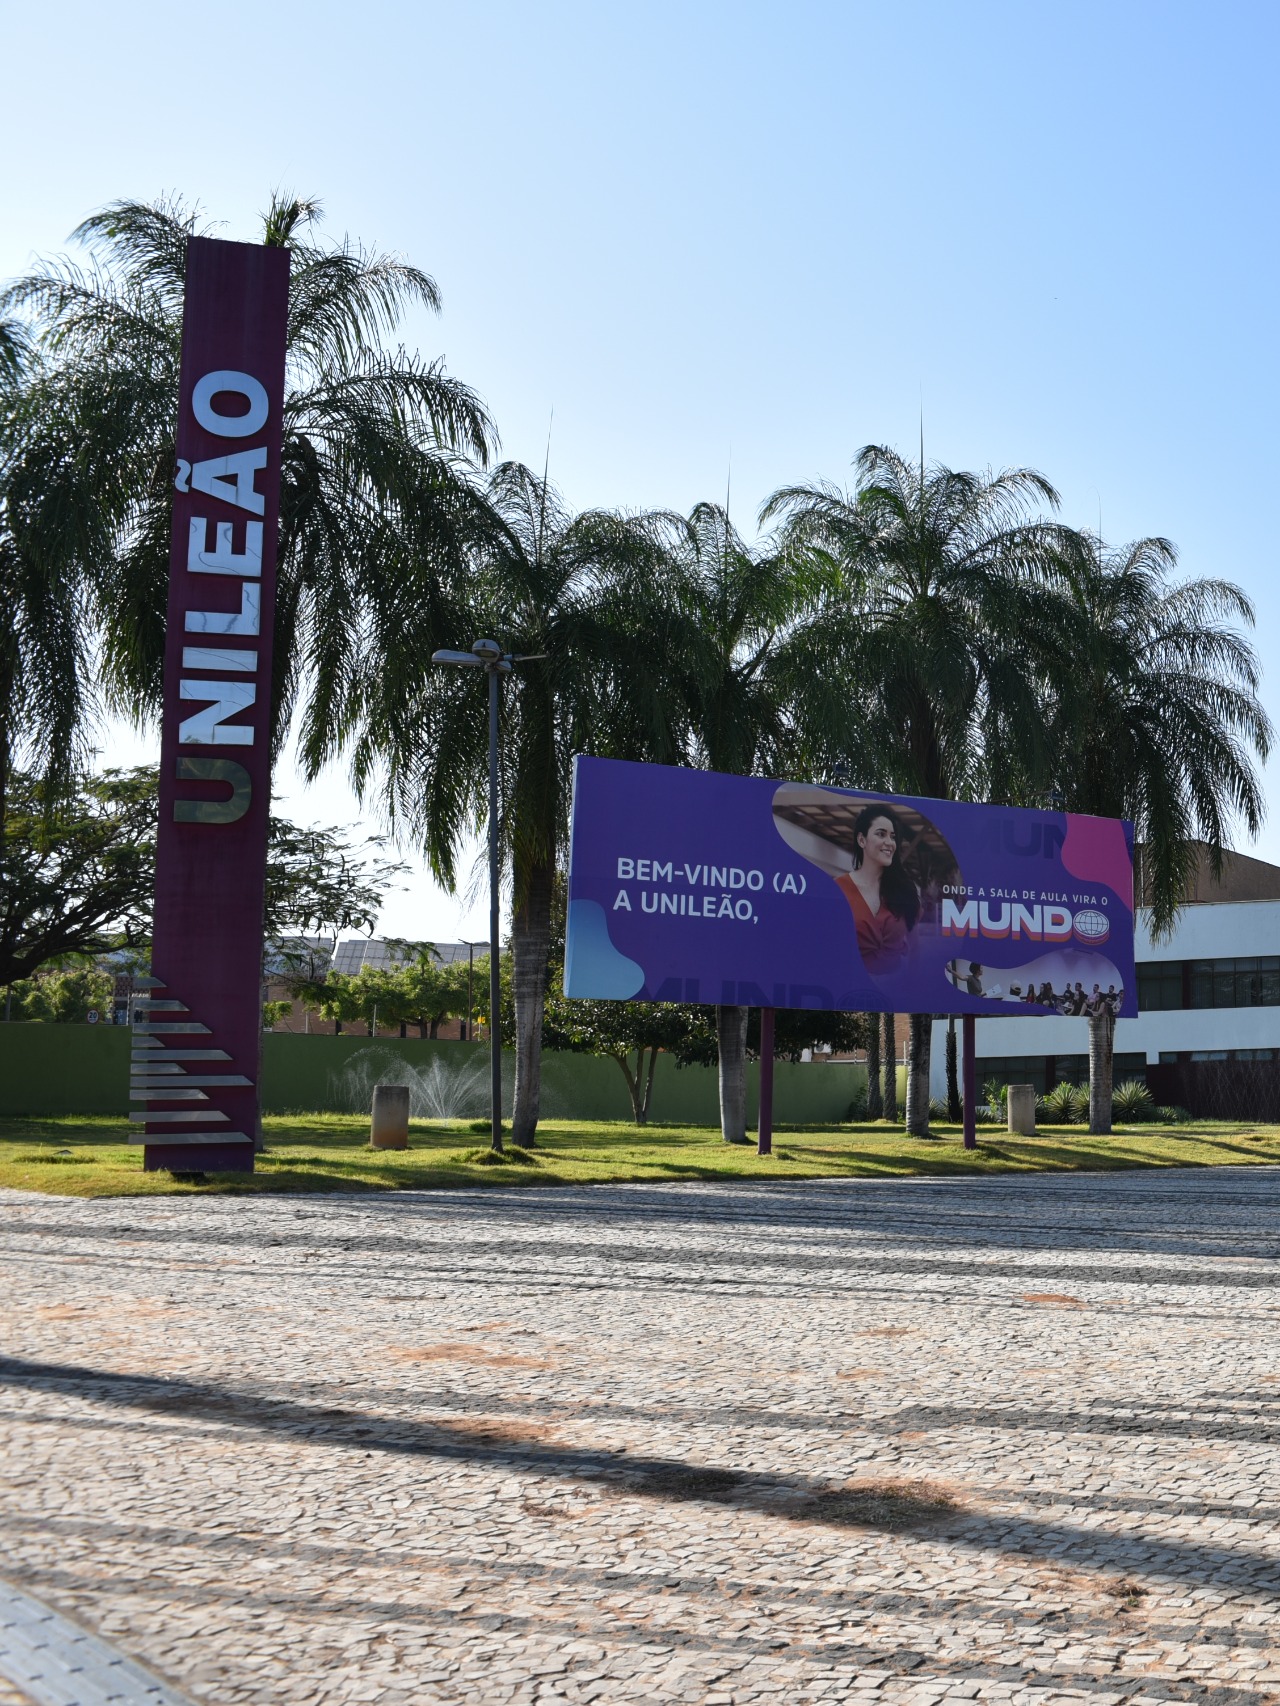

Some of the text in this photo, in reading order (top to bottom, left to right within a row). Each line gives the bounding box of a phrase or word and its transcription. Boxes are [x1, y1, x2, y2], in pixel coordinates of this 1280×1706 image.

[173, 369, 269, 825] UNILEÃO
[617, 857, 807, 895] BEM-VINDO (A)
[942, 884, 1108, 906] ONDE A SALA DE AULA VIRA O
[612, 889, 759, 925] A UNILEÃO,
[941, 898, 1110, 945] MUNDO
